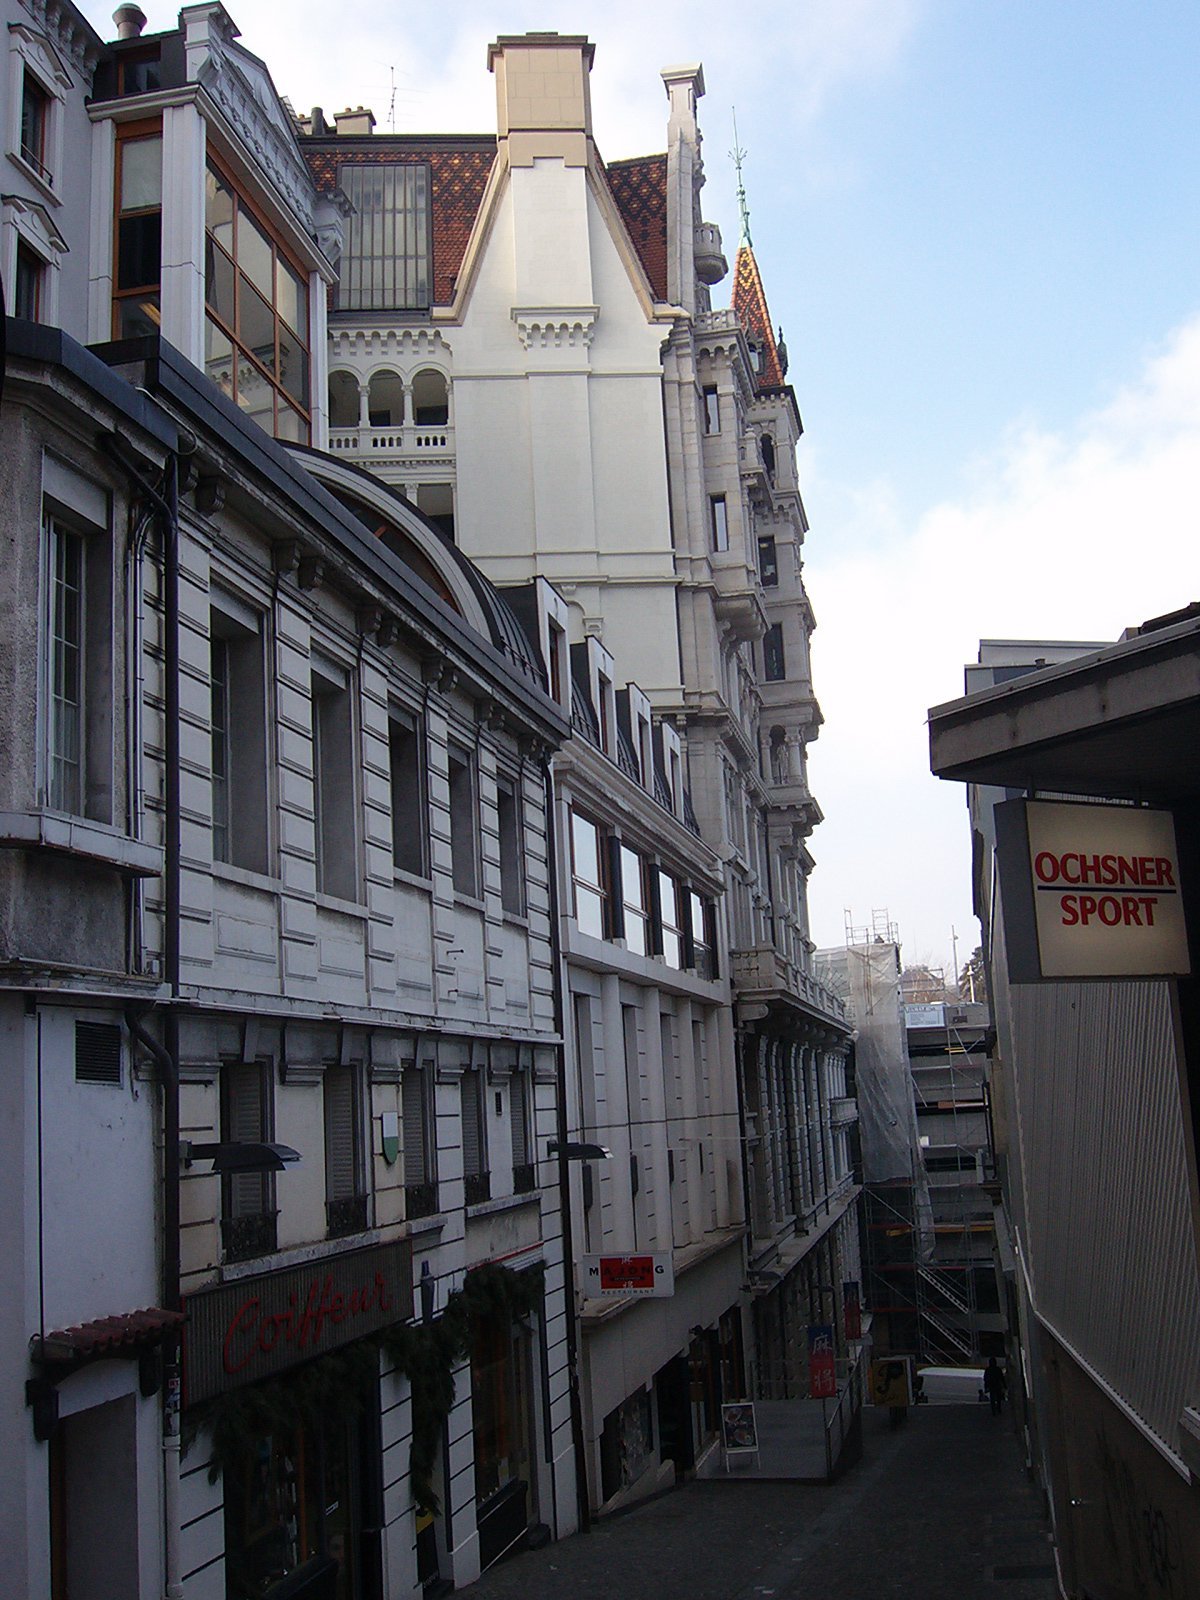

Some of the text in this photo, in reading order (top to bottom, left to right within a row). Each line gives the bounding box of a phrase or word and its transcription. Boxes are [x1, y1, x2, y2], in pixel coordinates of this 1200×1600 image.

[1034, 851, 1176, 886] OCHSNER
[1060, 894, 1158, 926] SPORT
[589, 1265, 664, 1276] MAJONG
[223, 1271, 391, 1375] Coiffeur
